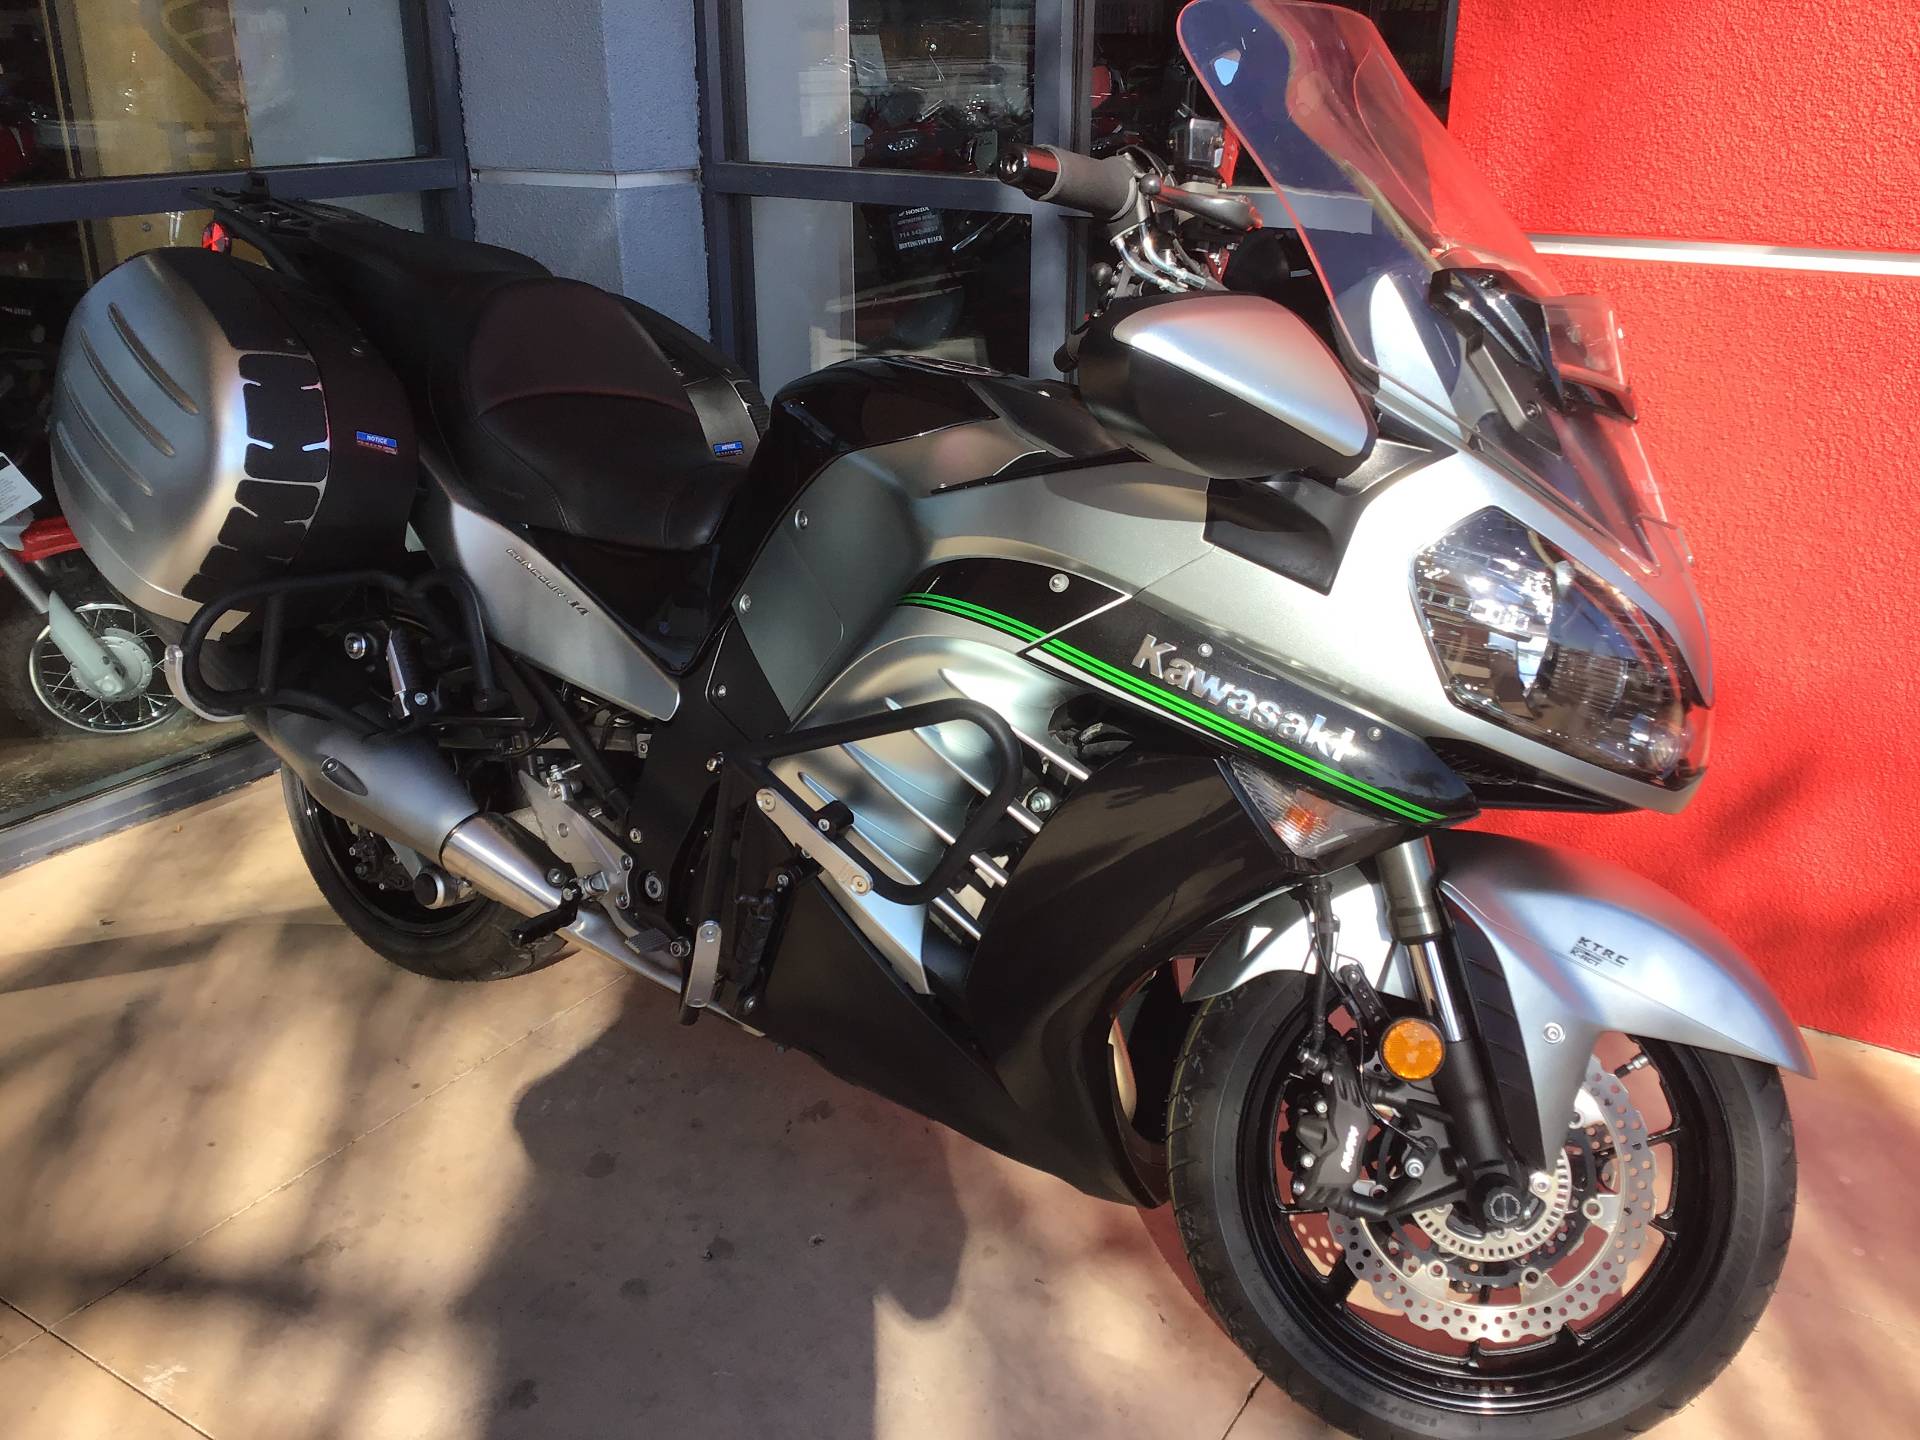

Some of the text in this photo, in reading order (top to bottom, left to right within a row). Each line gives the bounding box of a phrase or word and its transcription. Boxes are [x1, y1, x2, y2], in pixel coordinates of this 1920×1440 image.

[905, 206, 930, 216] HONDA
[367, 434, 388, 445] NOTICE
[1131, 633, 1356, 762] Kawasaki
[1577, 936, 1630, 966] KTRC
